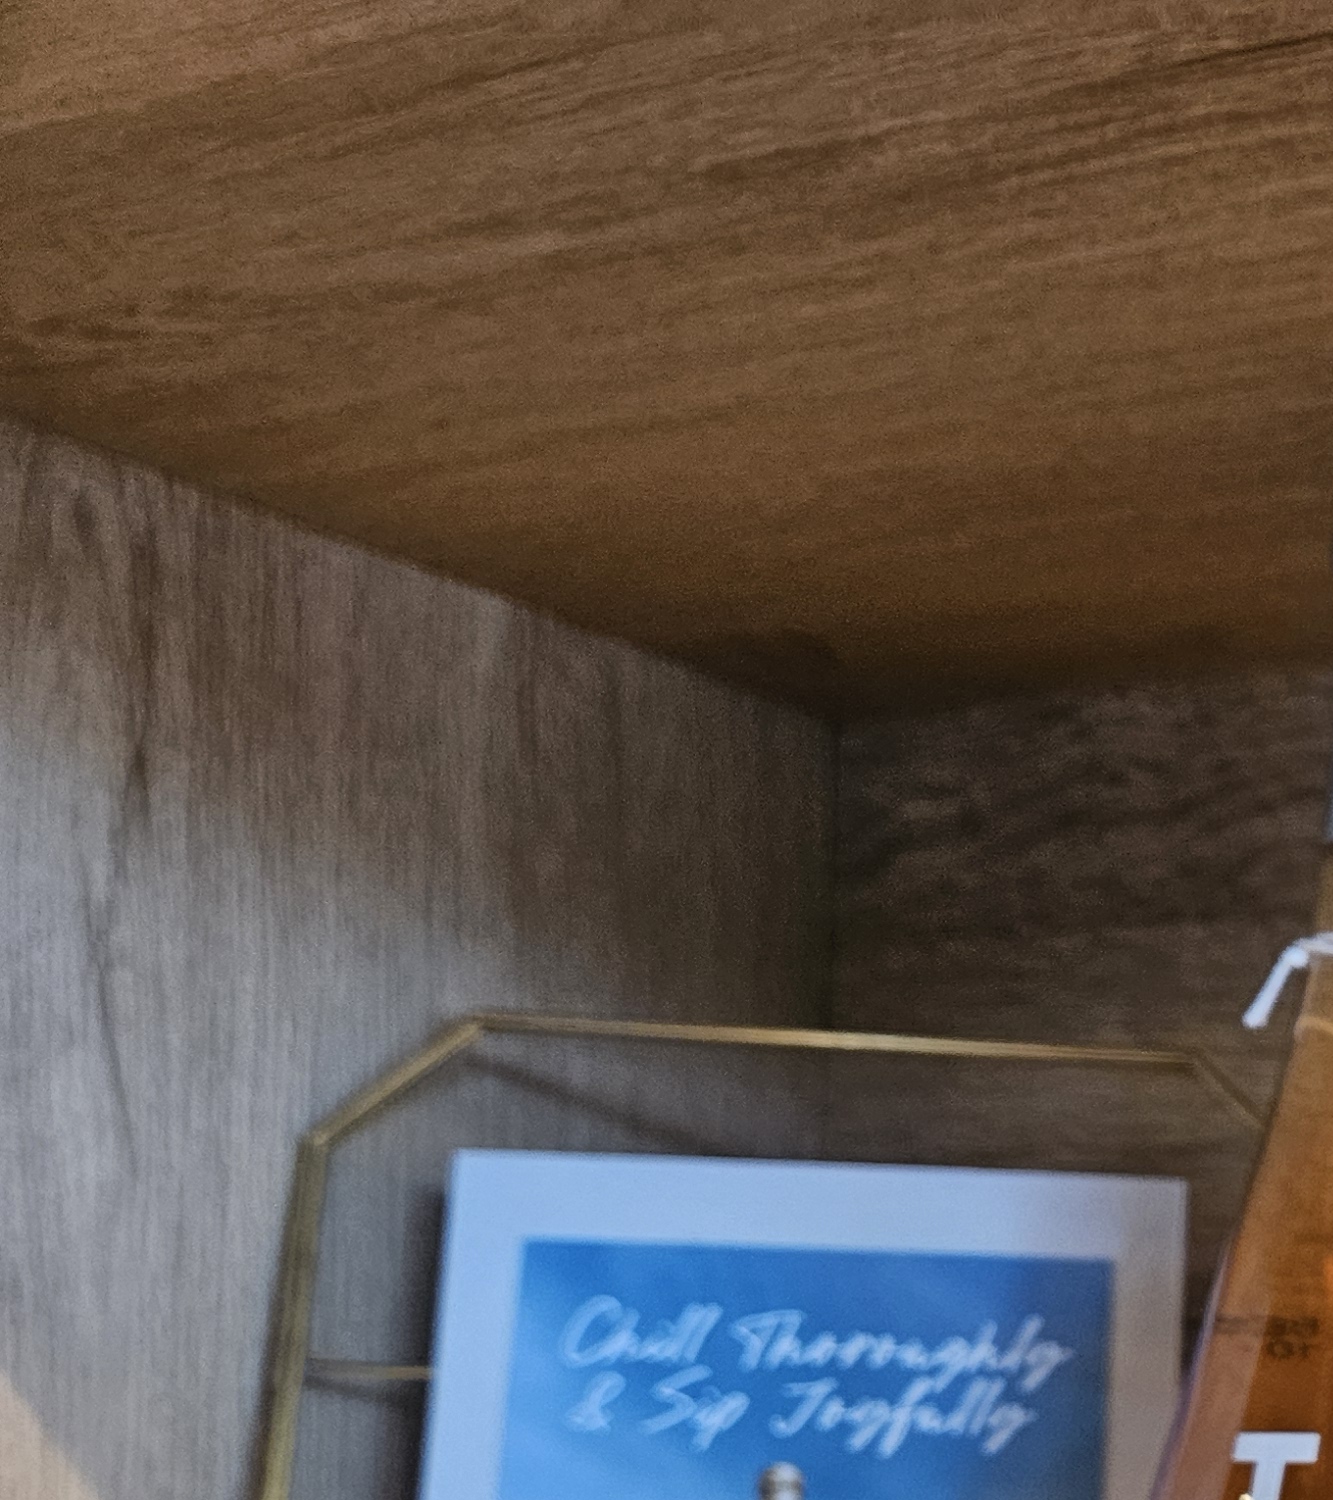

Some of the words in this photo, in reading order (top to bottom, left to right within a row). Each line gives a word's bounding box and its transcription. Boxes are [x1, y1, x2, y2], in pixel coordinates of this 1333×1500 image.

[562, 1294, 724, 1368] Chill
[729, 1309, 1074, 1392] Thoroughly
[566, 1370, 626, 1434] &
[637, 1364, 751, 1451] Sip
[768, 1377, 1037, 1458] Joyfully
